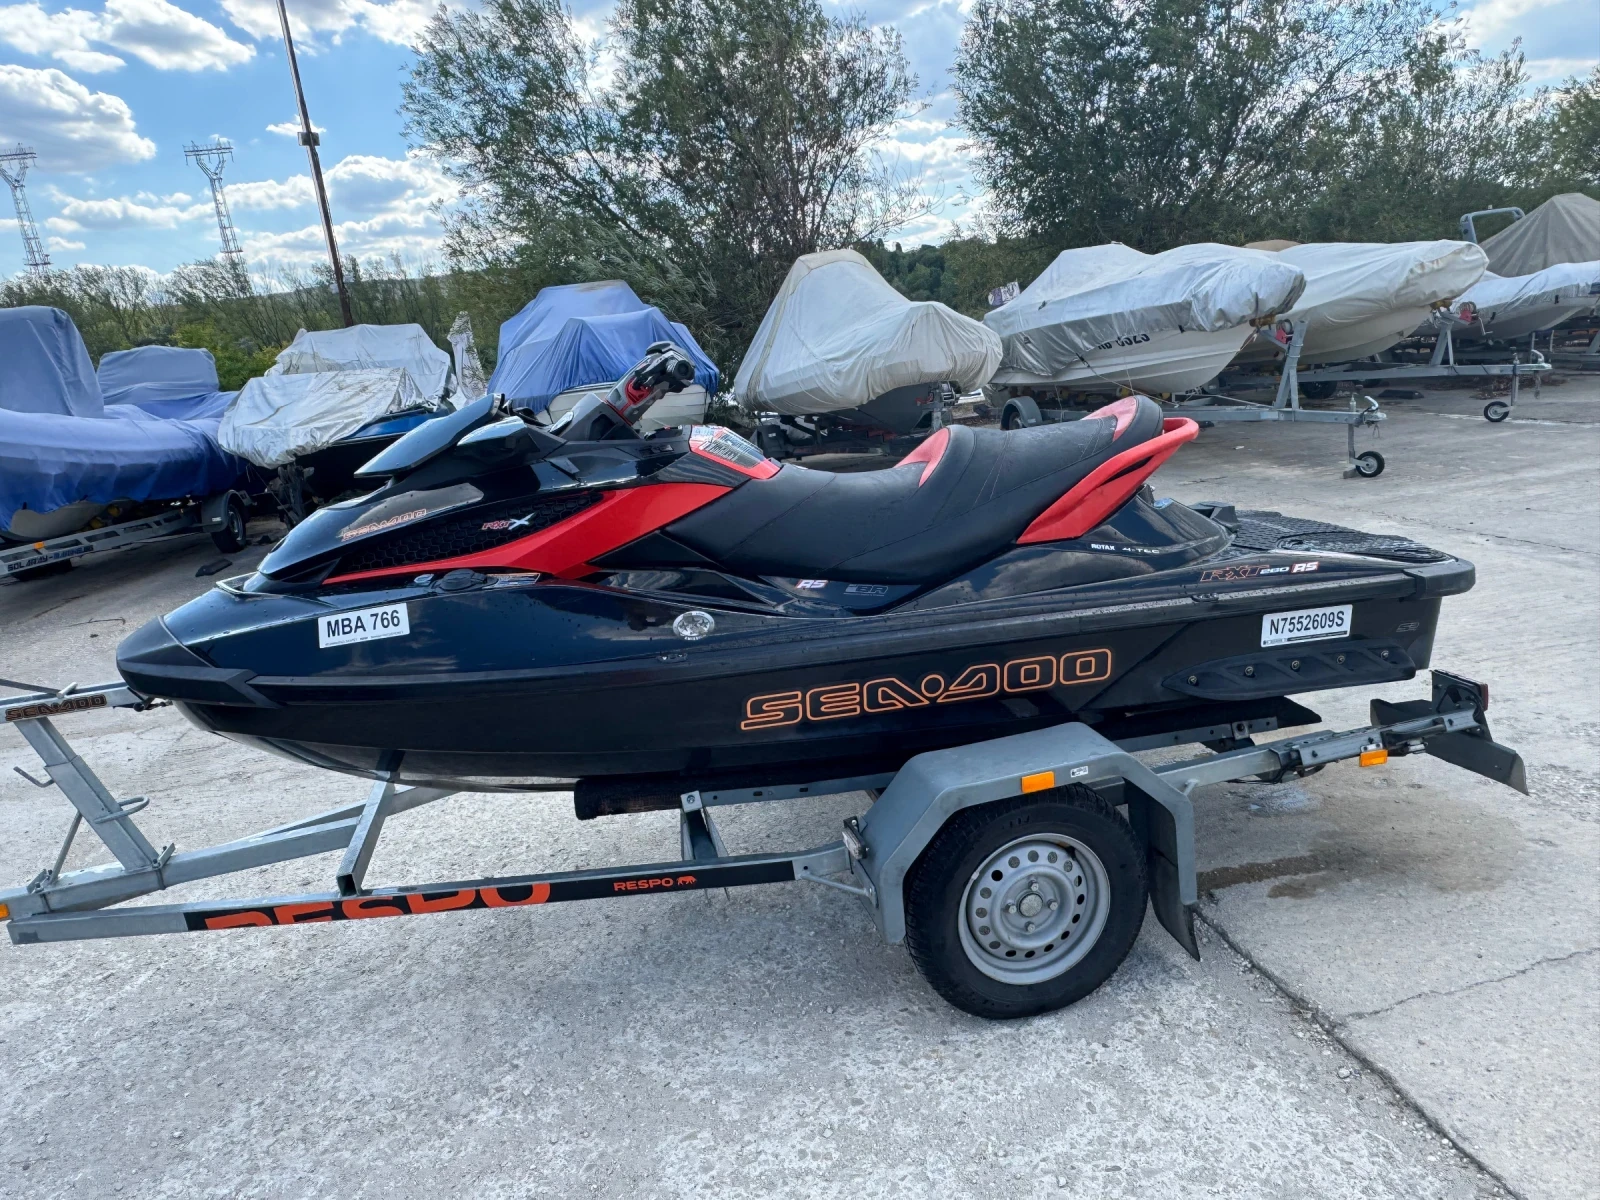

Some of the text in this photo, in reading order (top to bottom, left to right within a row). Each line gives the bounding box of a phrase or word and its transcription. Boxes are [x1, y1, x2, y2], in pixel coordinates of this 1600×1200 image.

[1090, 543, 1115, 551] ROTAX
[1200, 564, 1269, 581] RXT
[1291, 561, 1319, 573] RS
[327, 609, 401, 638] MBA 766
[1269, 610, 1345, 636] N7552609S
[613, 877, 674, 892] RESPO
